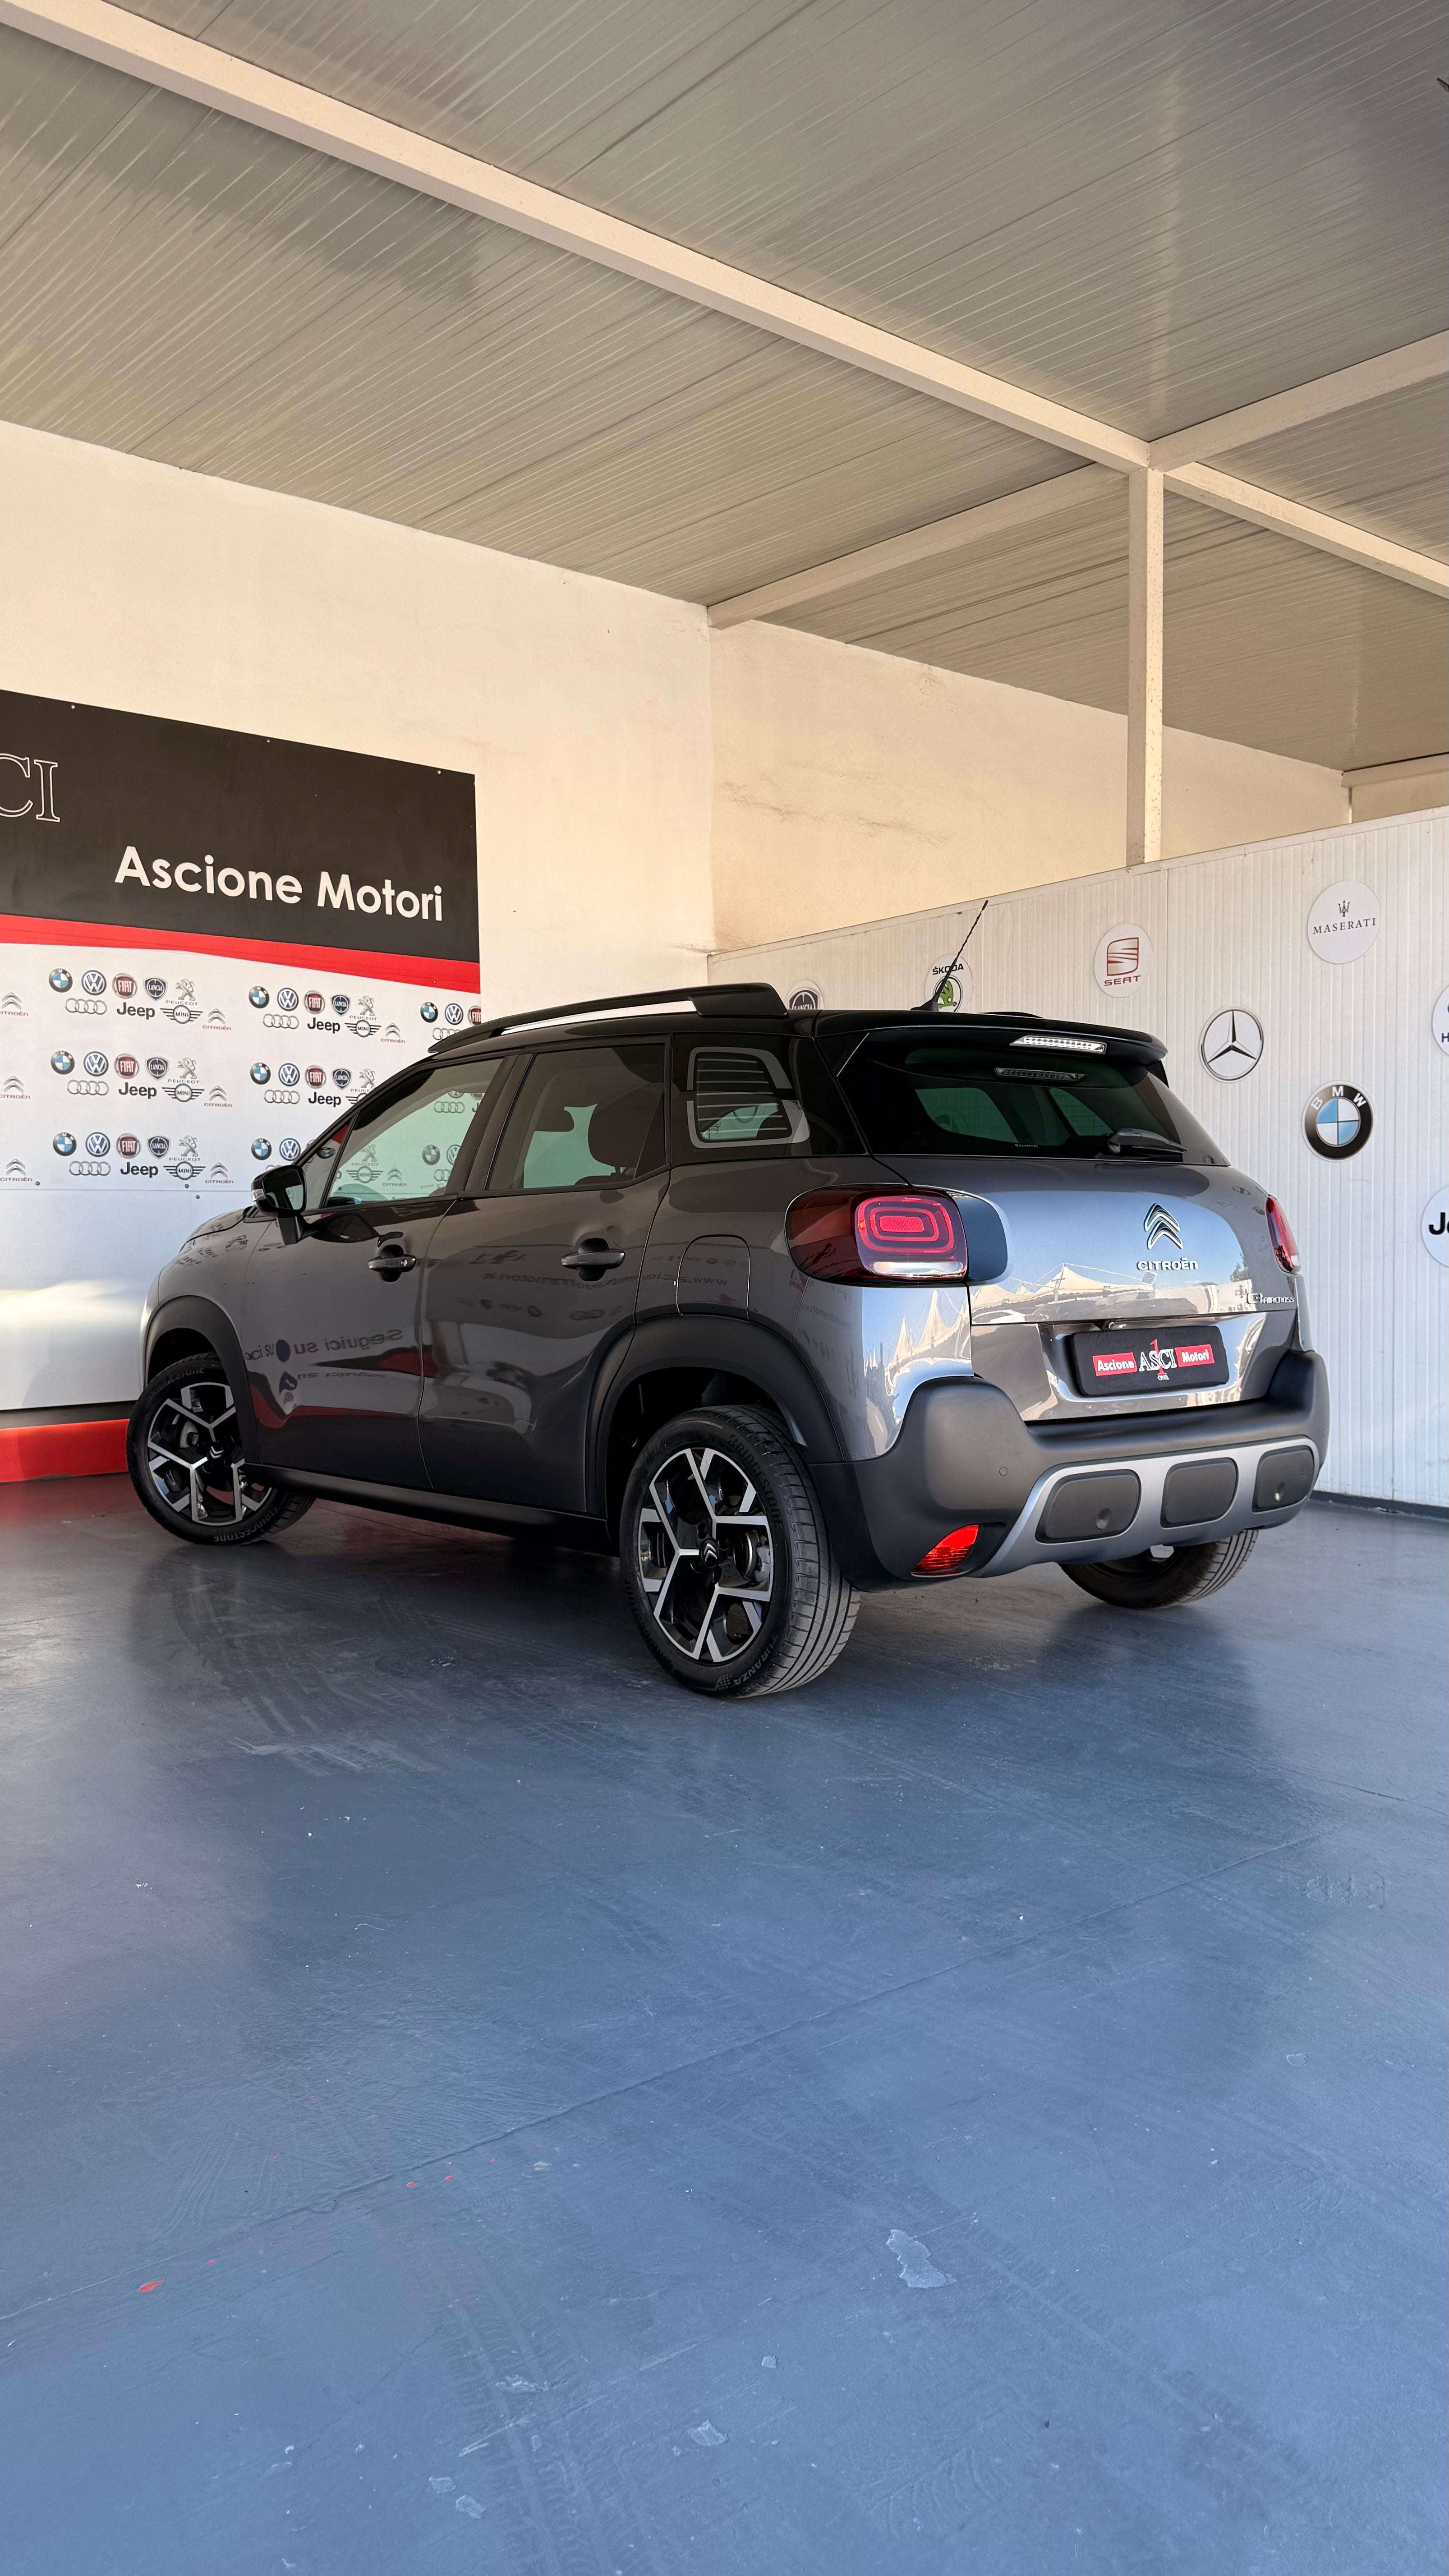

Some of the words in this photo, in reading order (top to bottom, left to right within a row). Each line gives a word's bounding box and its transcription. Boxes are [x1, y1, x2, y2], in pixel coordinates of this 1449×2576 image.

[115, 845, 302, 904] Ascione
[317, 871, 442, 921] Motori
[1313, 918, 1375, 934] MASERATI
[118, 980, 133, 992] FIAT
[1104, 975, 1141, 986] SEAT
[308, 997, 321, 1008] FIAT
[116, 1002, 156, 1020] Jeep
[472, 1012, 481, 1022] FIA
[307, 1017, 340, 1034] Jeep
[120, 1061, 135, 1072] FIAT
[309, 1072, 322, 1083] FIAT
[118, 1082, 157, 1099] Jeep
[308, 1092, 341, 1107] Jeep
[1311, 1086, 1366, 1111] BMW
[121, 1141, 136, 1152] FIAT
[120, 1162, 159, 1178] Jeep
[1137, 1257, 1198, 1270] CITROËN
[1097, 1358, 1135, 1372] Ascione
[1139, 1348, 1178, 1372] ASCI
[1181, 1349, 1210, 1363] Motori
[734, 1635, 778, 1685] TURANZA
